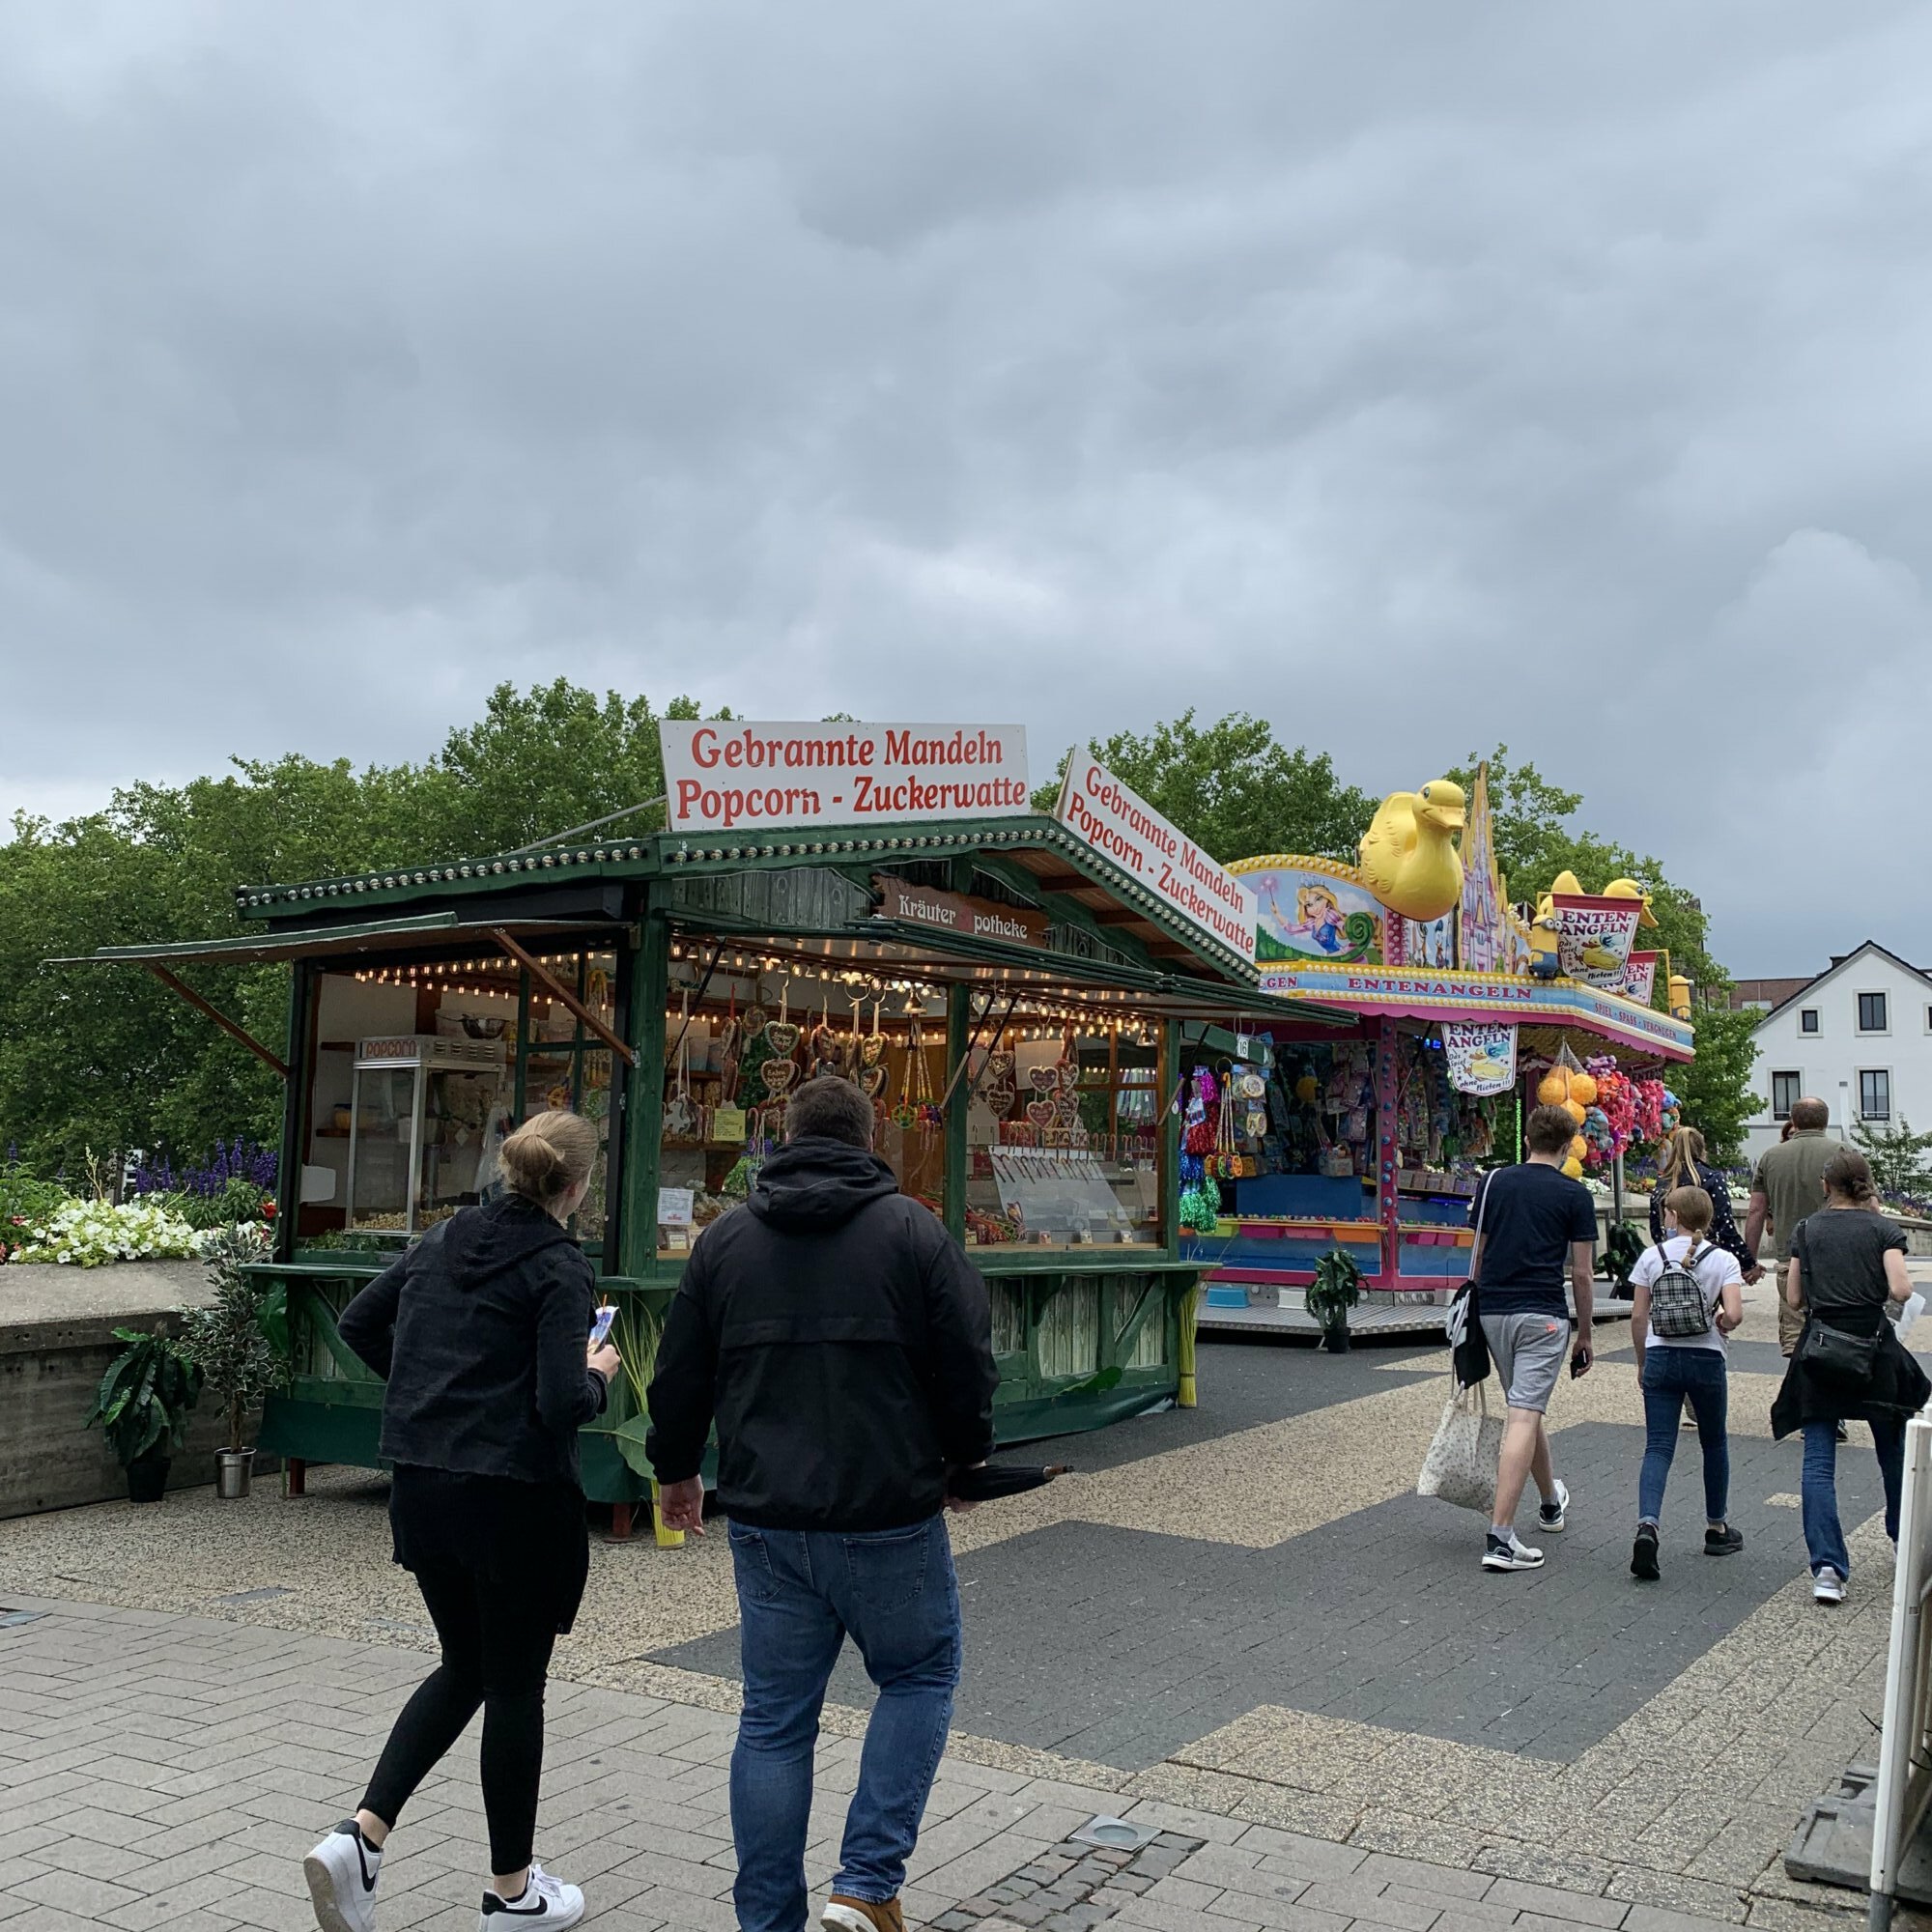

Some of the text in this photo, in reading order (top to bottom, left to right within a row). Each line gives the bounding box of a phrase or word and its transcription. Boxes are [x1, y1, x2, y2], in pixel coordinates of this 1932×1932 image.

[692, 728, 1003, 768] Gebrannte Mandeln
[677, 779, 821, 828] Popcorn
[853, 775, 1026, 812] Zuckerwatte
[1086, 766, 1244, 914] Gebrannte Mandeln
[1067, 791, 1143, 872] Popcorn
[1158, 862, 1254, 954] Zuckerwatte
[898, 894, 956, 924] Kräuter
[1561, 910, 1633, 924] ENTEN-
[1559, 923, 1630, 936] ANGELN
[1348, 977, 1532, 1000] ENTENANGELN
[1594, 1002, 1612, 1017] SPIEL
[1618, 1010, 1637, 1026] SPASS
[1239, 1040, 1247, 1055] 16
[1447, 1033, 1511, 1048] ANGELN
[1460, 1080, 1478, 1089] ohne
